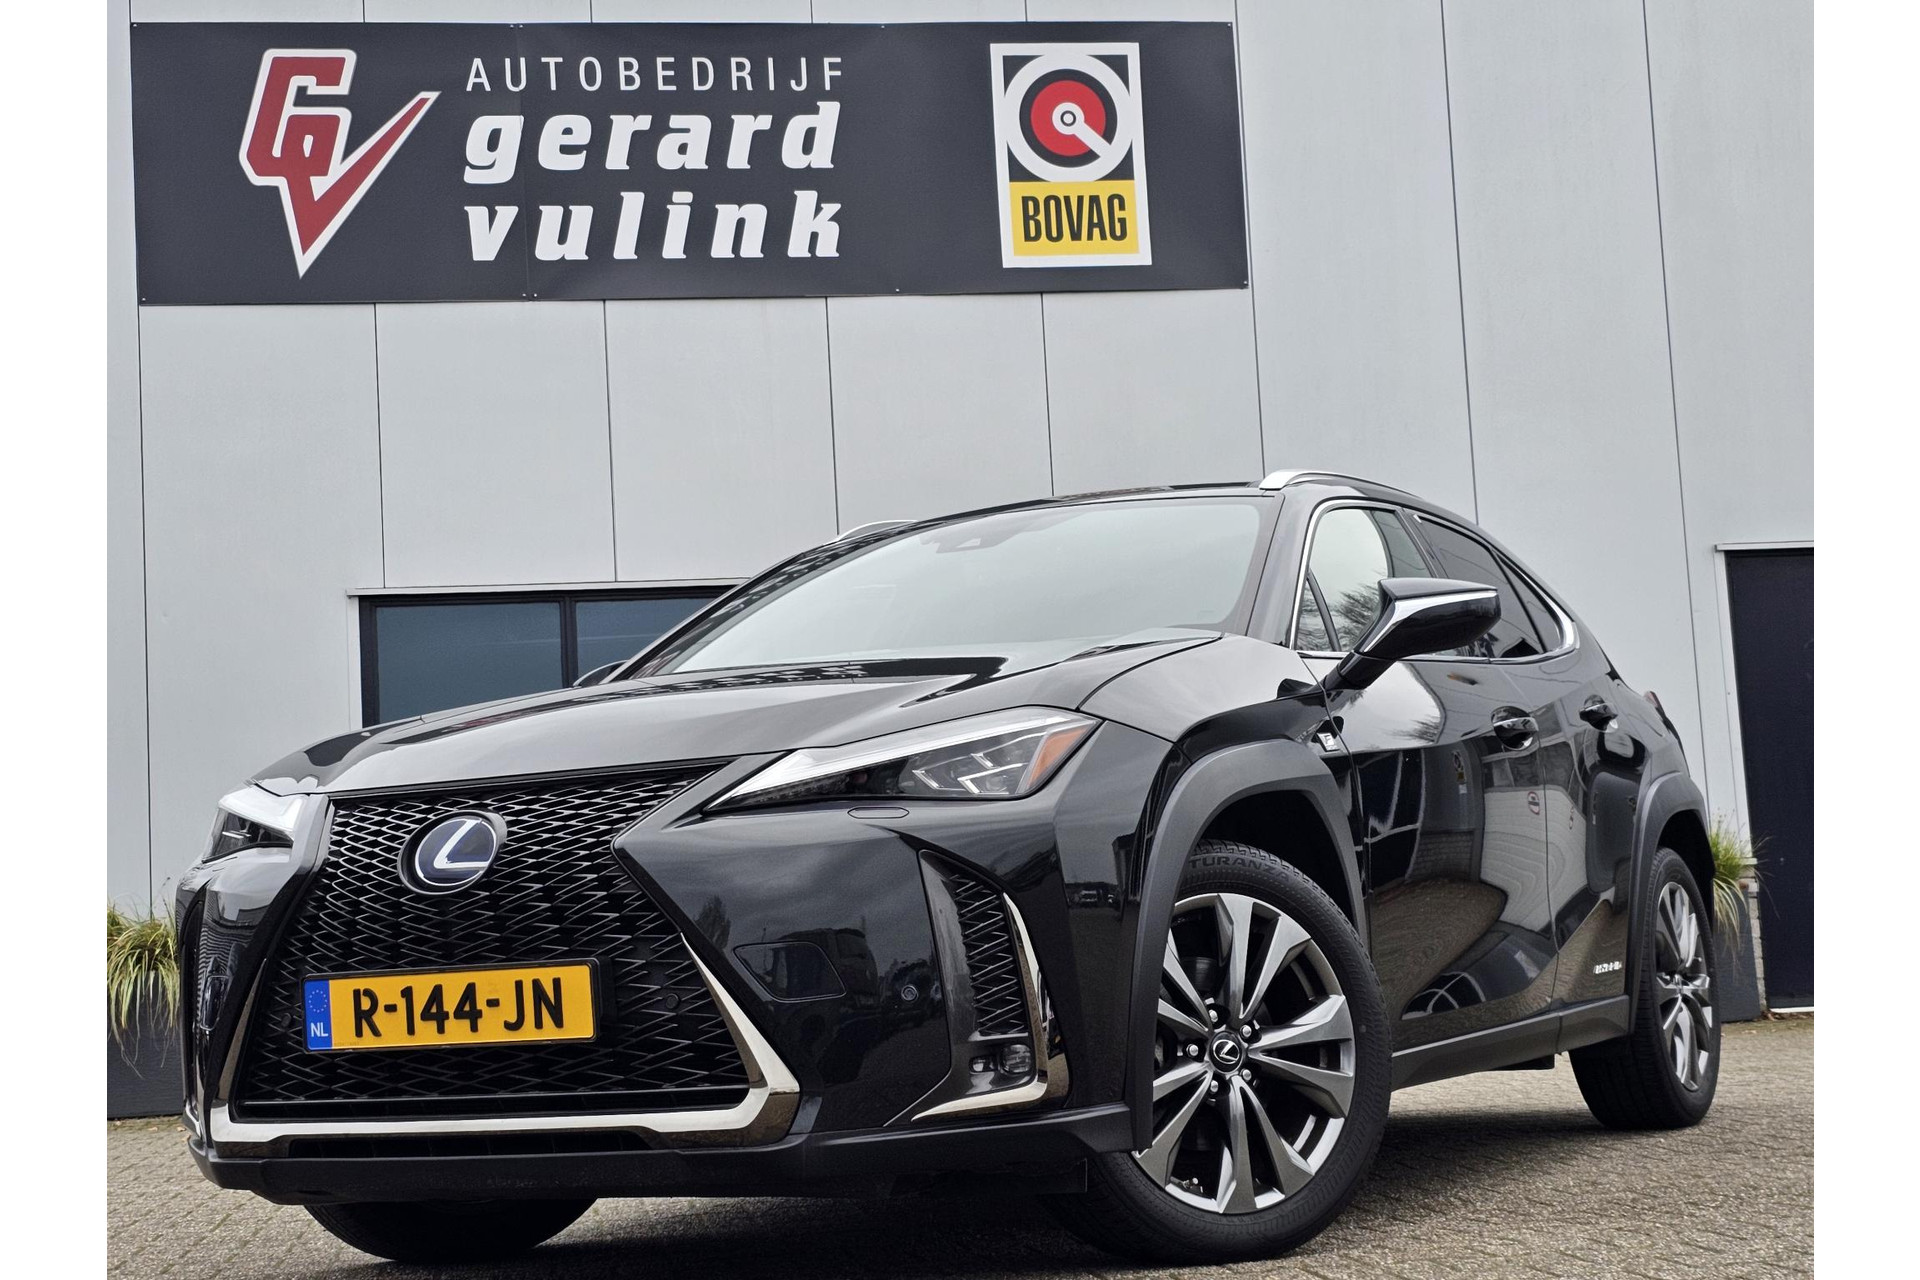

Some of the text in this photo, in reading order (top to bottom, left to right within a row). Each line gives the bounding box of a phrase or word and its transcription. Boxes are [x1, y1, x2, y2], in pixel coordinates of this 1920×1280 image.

[466, 57, 843, 92] AUTOBEDRIJF
[463, 101, 842, 184] gerard
[463, 190, 843, 261] vulink
[1021, 193, 1128, 242] BOVAG
[1189, 855, 1291, 882] TURANZA
[310, 1022, 329, 1037] NL
[352, 976, 564, 1038] R-144-JN
